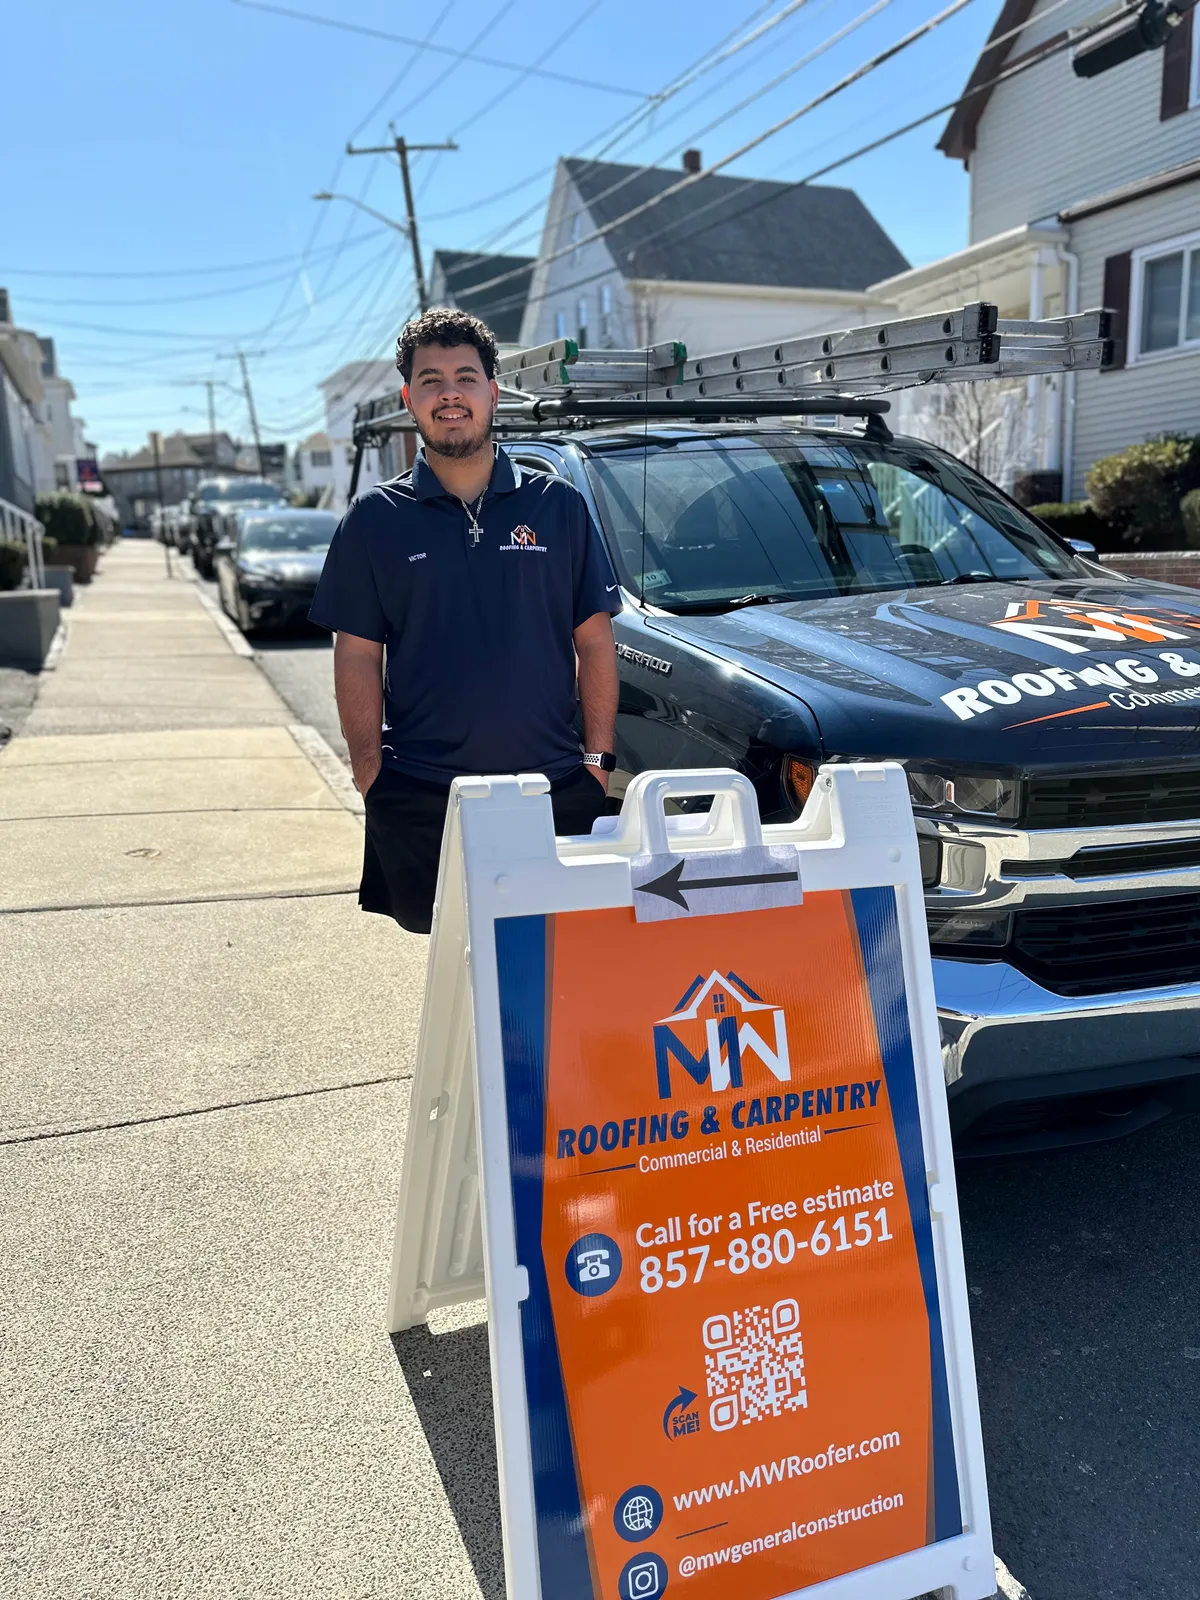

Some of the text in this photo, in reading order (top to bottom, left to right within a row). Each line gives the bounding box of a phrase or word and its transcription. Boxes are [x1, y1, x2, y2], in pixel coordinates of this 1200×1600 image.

[408, 552, 427, 562] VICTOR
[615, 642, 672, 673] VERADO
[1159, 652, 1200, 677] &
[653, 1009, 792, 1100] MW
[556, 1079, 881, 1159] ROOFING & CARPENTRY
[639, 1125, 822, 1173] Commercial & Residential
[635, 1179, 894, 1248] Call for a Free estimate
[640, 1207, 893, 1294] 857-880-6151
[673, 1411, 699, 1425] SCAN
[673, 1420, 700, 1438] ME!
[673, 1431, 901, 1511] www.MWRoofer.com
[678, 1493, 904, 1577] @mwgeneralconstruction
